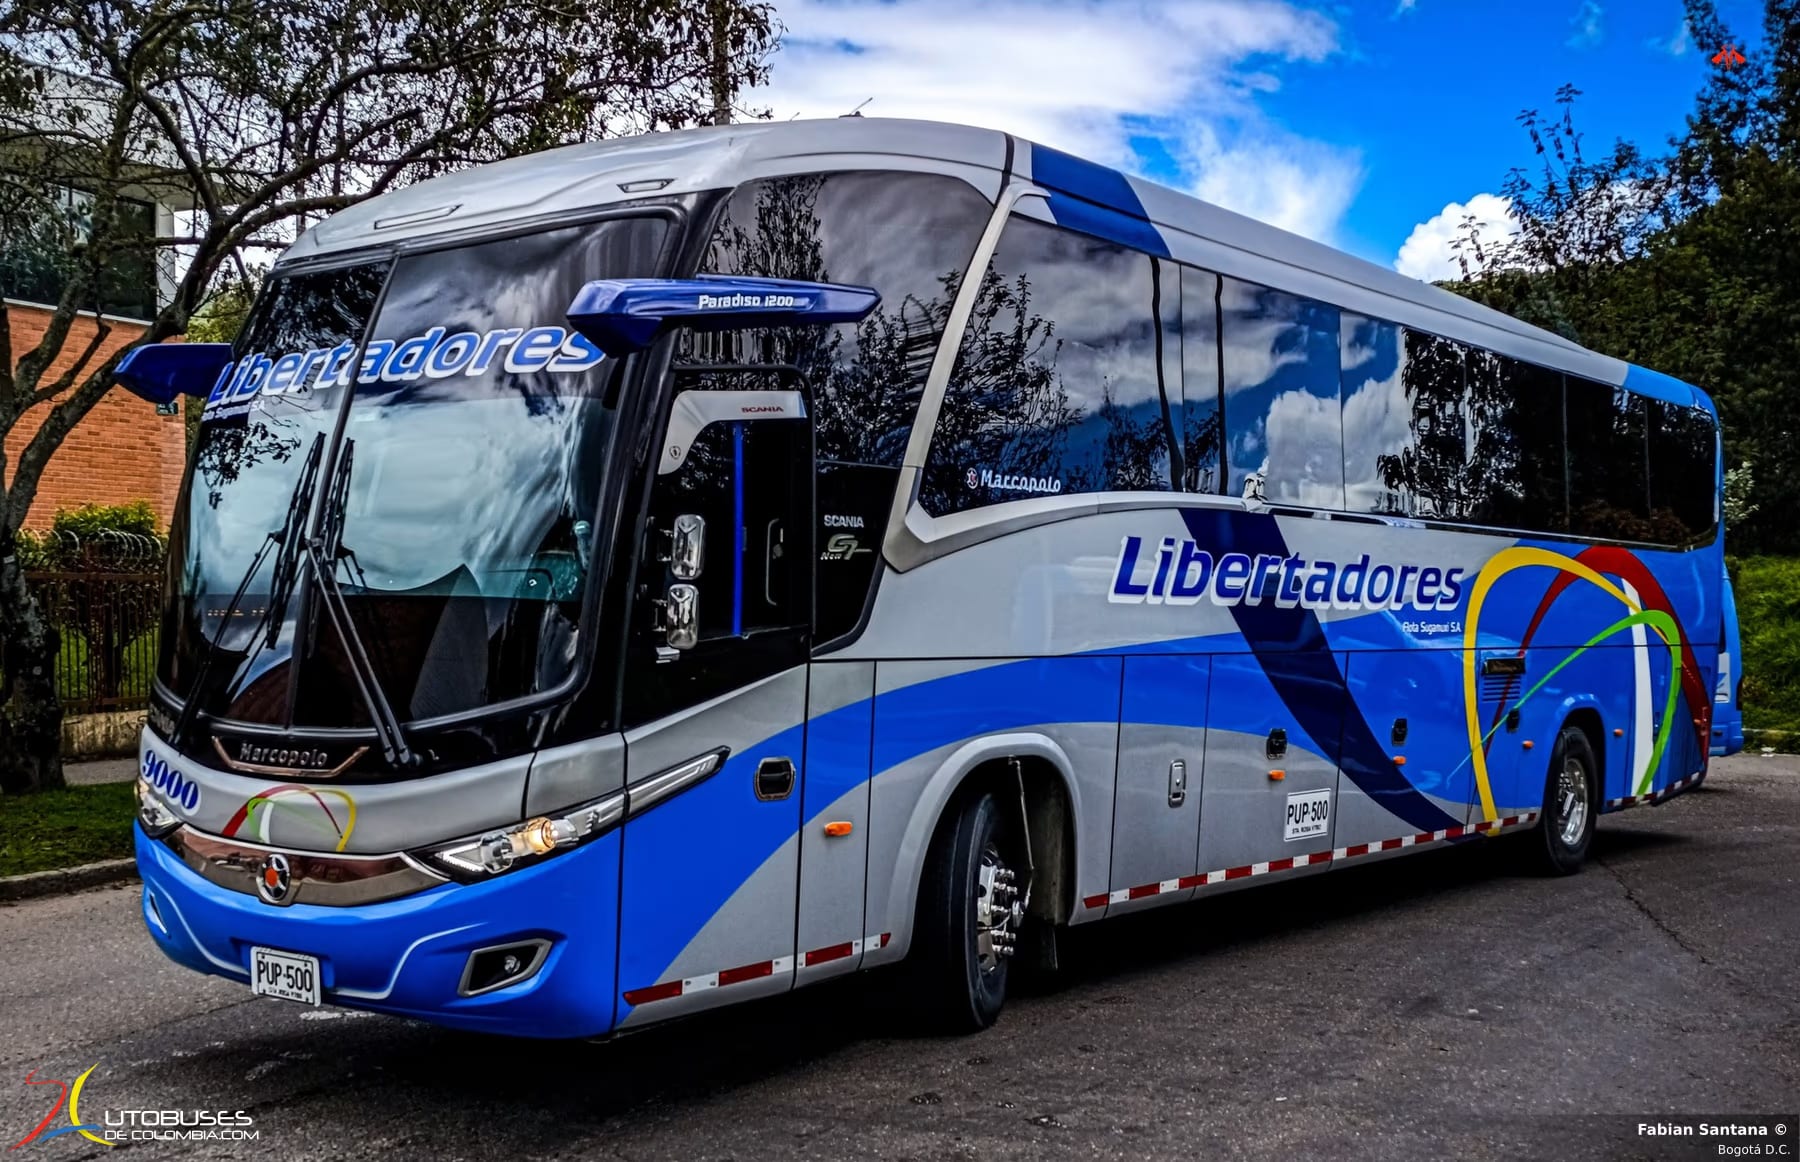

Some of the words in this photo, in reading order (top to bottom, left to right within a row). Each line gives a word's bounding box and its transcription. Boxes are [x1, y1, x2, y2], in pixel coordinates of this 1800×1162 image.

[698, 294, 761, 309] Paradiso
[764, 295, 794, 307] 1200
[205, 326, 606, 410] Libertadores
[981, 469, 1061, 493] Marcopolo
[823, 514, 865, 528] SCANIA
[1107, 535, 1465, 611] Libertadores
[239, 742, 329, 768] Marcopolo
[141, 749, 200, 811] 9000
